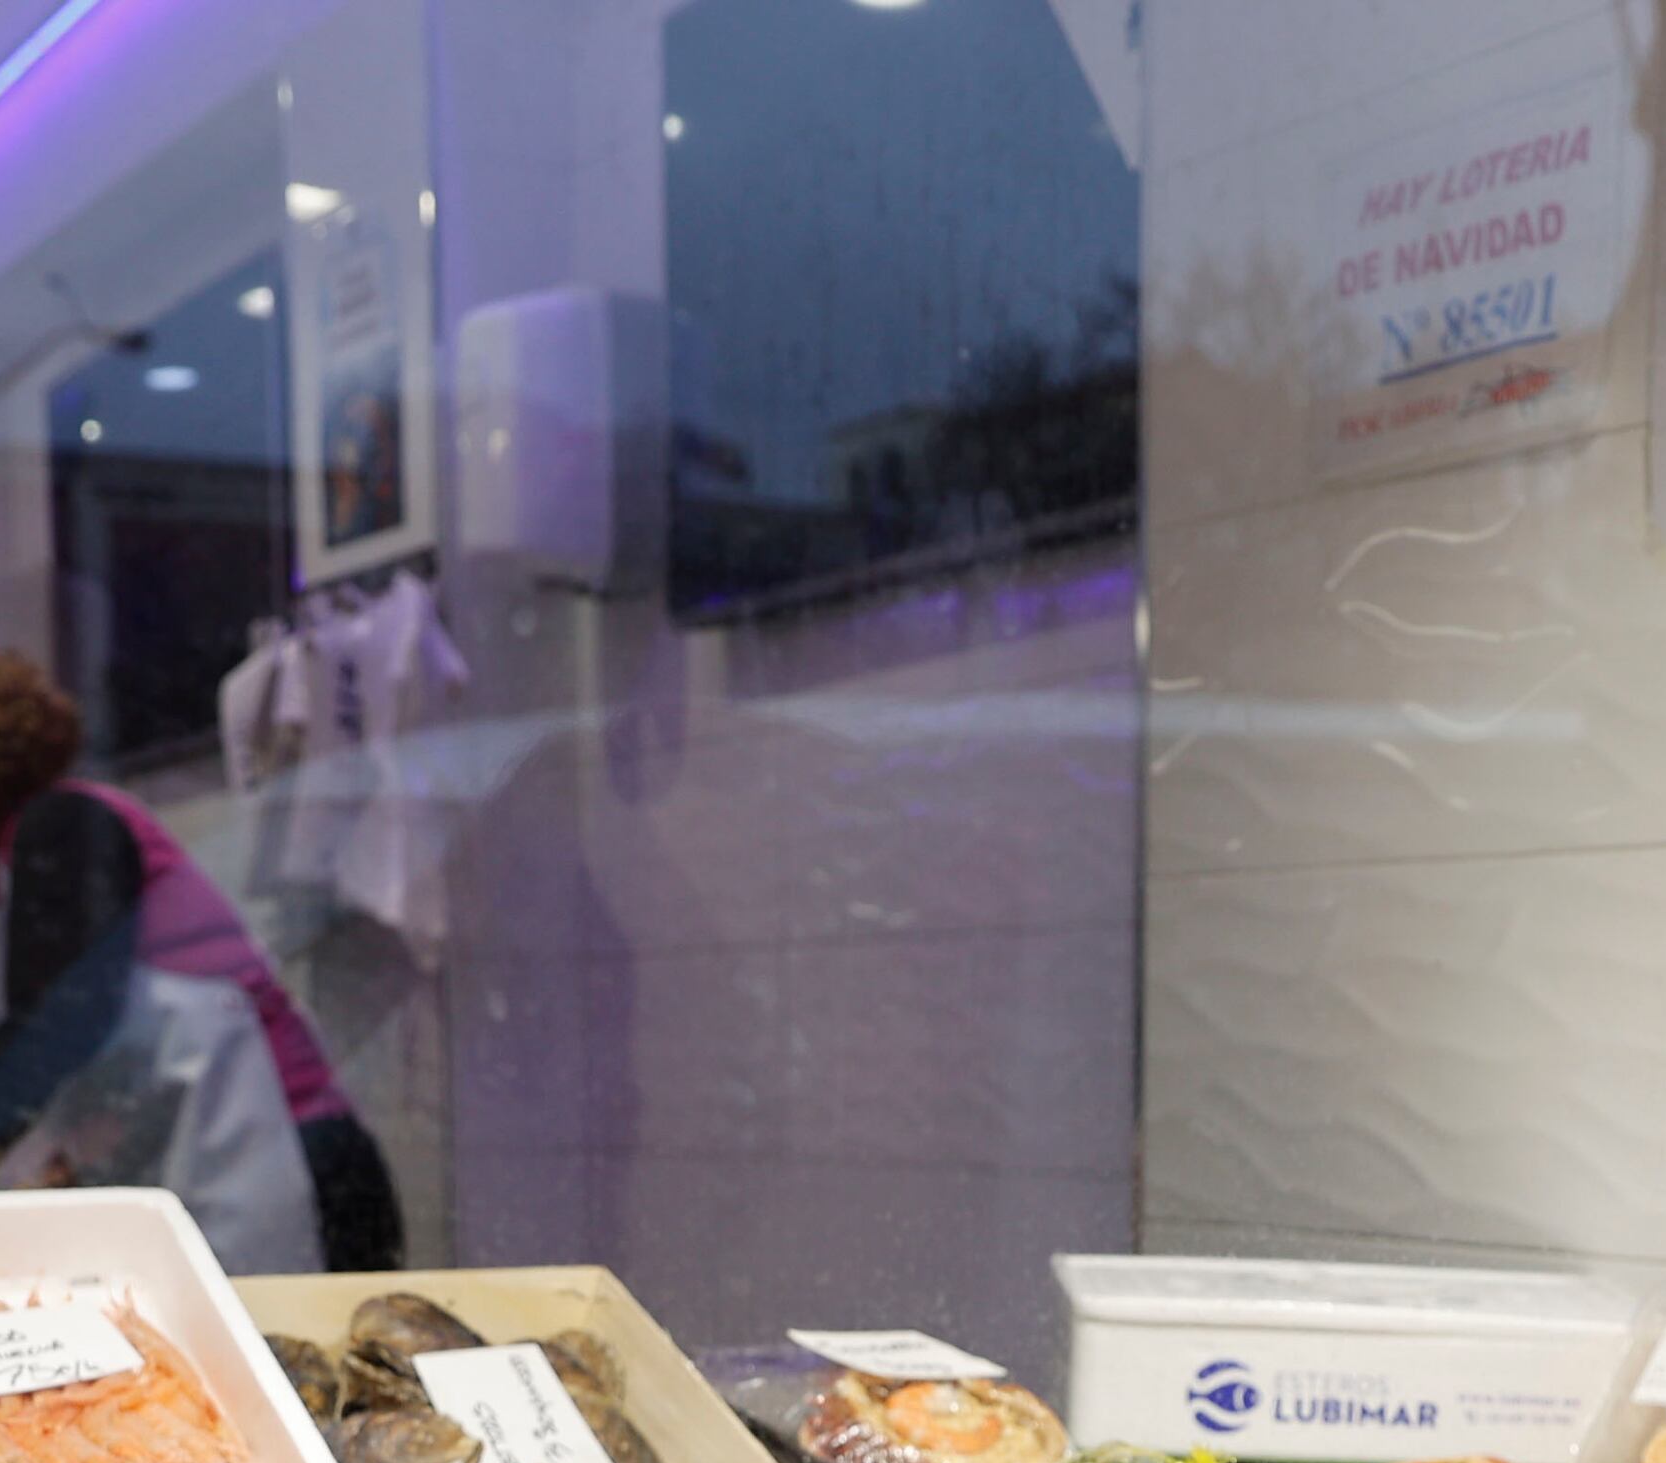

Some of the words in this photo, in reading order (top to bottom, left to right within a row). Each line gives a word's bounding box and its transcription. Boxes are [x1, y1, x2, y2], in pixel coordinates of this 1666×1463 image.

[1358, 172, 1433, 228] HAY
[1438, 126, 1592, 205] LOTERIA
[1337, 248, 1381, 298] DE
[1394, 203, 1566, 285] NAVIDAD
[1273, 1370, 1391, 1397] ESTEROS
[1273, 1396, 1440, 1429] LUBIMAR
